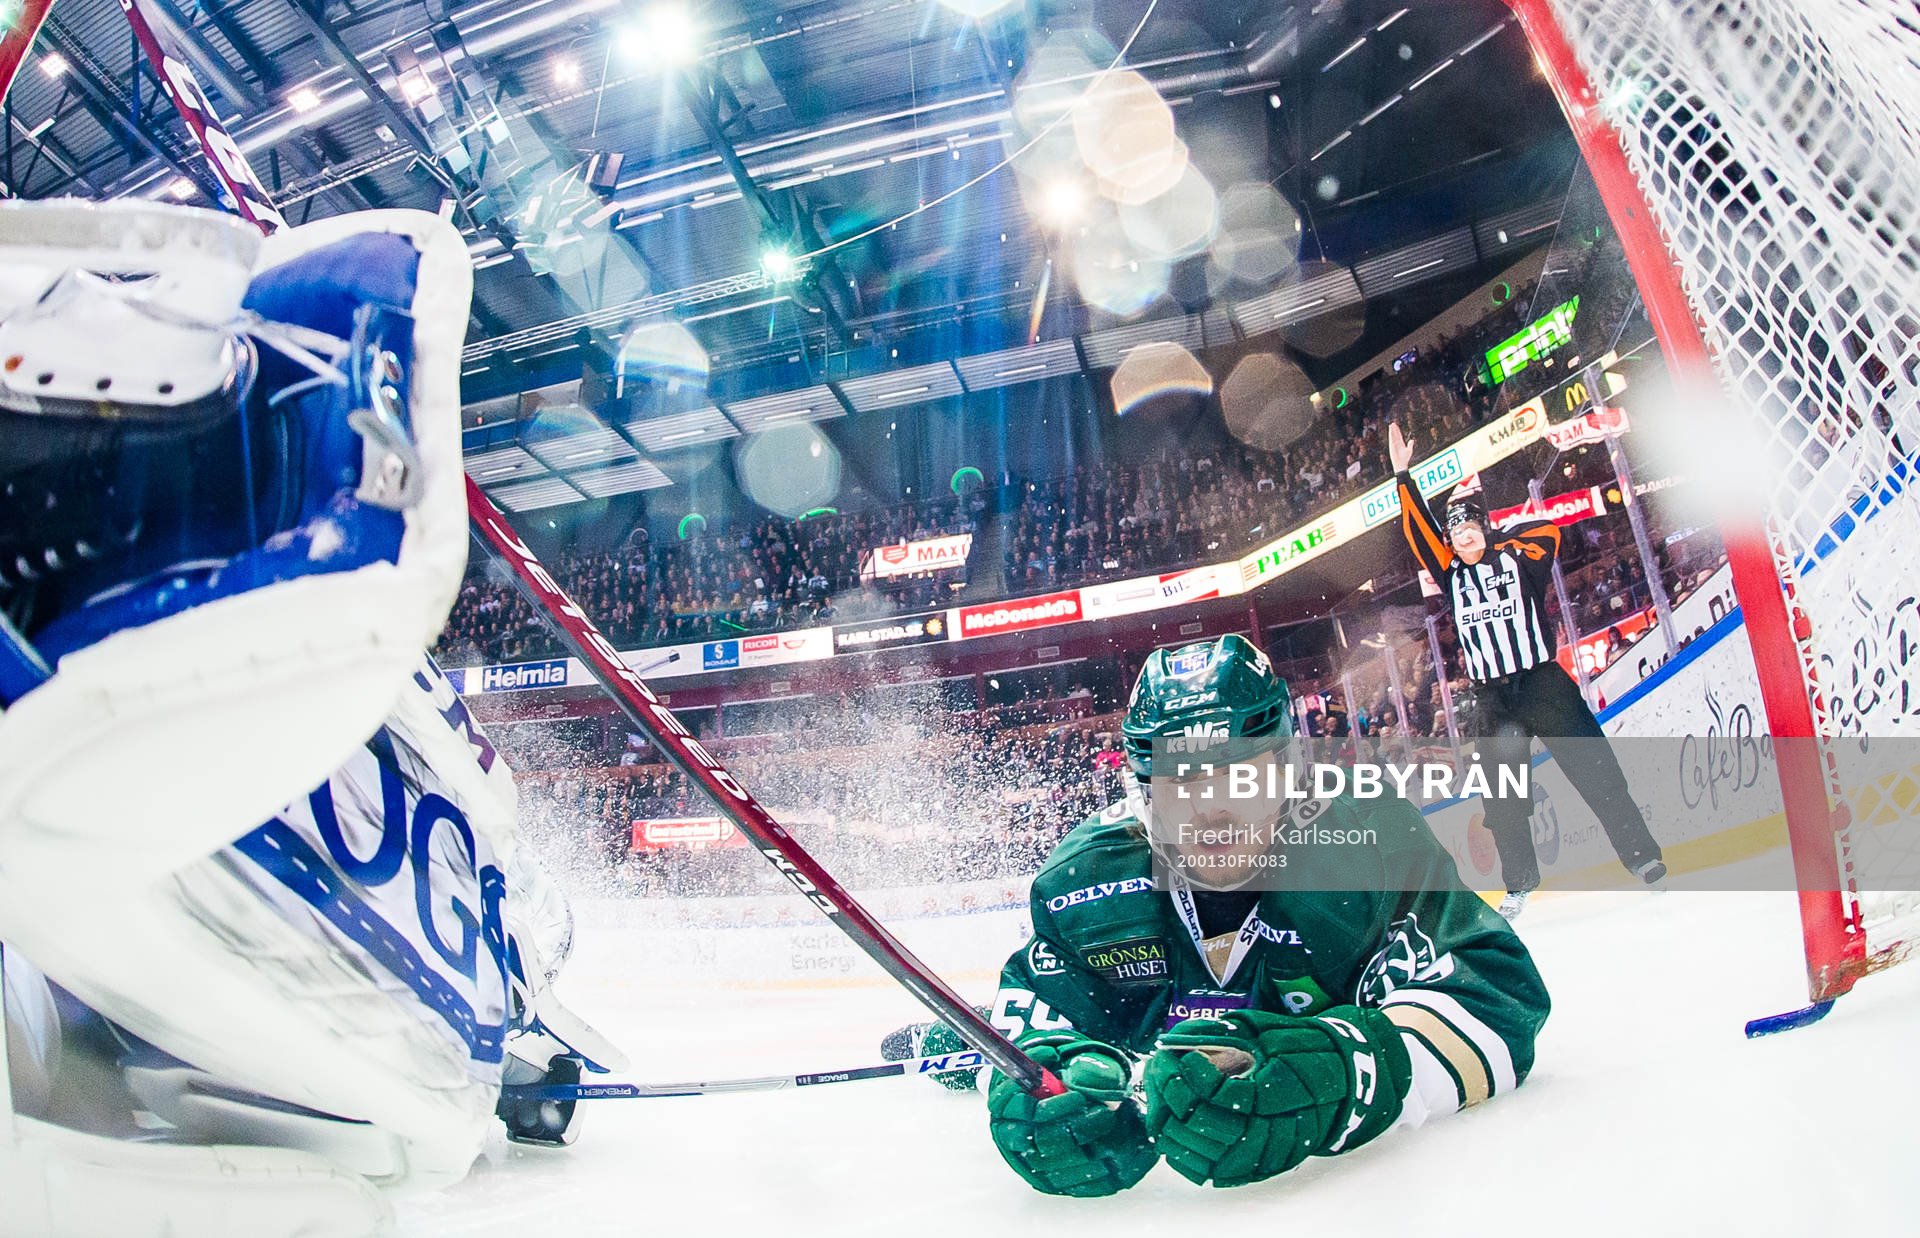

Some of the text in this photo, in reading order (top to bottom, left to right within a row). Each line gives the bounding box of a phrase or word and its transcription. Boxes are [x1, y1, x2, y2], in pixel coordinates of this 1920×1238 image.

[1256, 528, 1324, 575] PEAB
[1486, 571, 1514, 588] SHL
[966, 599, 1077, 630] McDonald's
[1462, 599, 1517, 625] swedol
[744, 638, 777, 650] RICOH
[484, 666, 566, 690] Helmia
[1163, 691, 1217, 711] CCM
[1046, 876, 1159, 914] OELVEN
[818, 1073, 848, 1083] BRAGE
[584, 1087, 632, 1096] PREMIER
